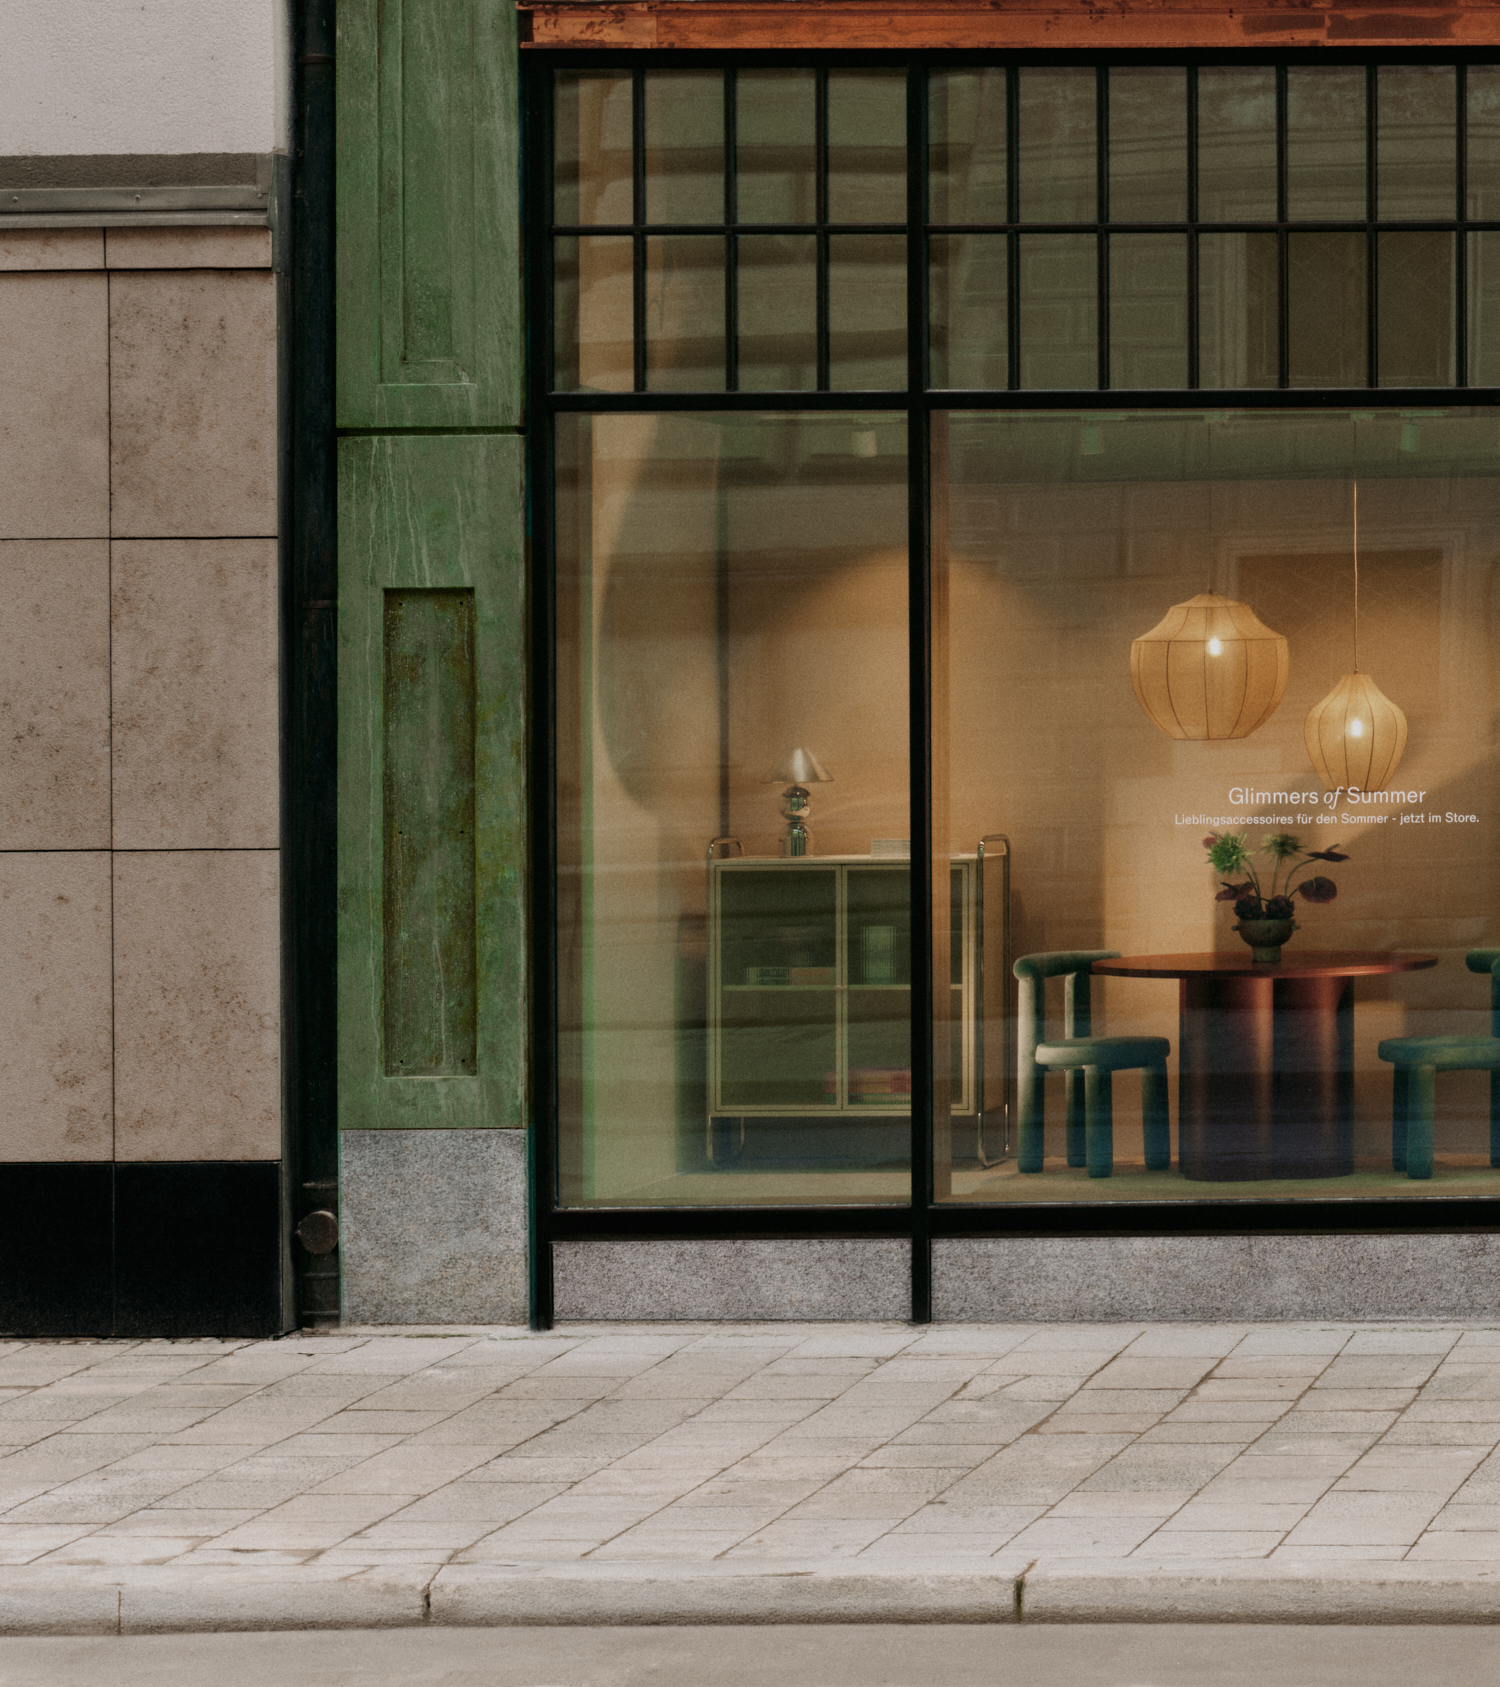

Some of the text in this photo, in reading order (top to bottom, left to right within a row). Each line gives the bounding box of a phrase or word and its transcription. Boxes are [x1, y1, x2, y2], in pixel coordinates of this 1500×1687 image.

[1228, 786, 1426, 810] Glimmers of Summer
[1175, 814, 1293, 826] Lieblingsaccessoires
[1296, 813, 1313, 824] für
[1316, 813, 1338, 824] den
[1341, 812, 1389, 824] Sommer
[1399, 812, 1425, 825] jetzt
[1428, 812, 1442, 823] im
[1445, 812, 1480, 823] Store.
